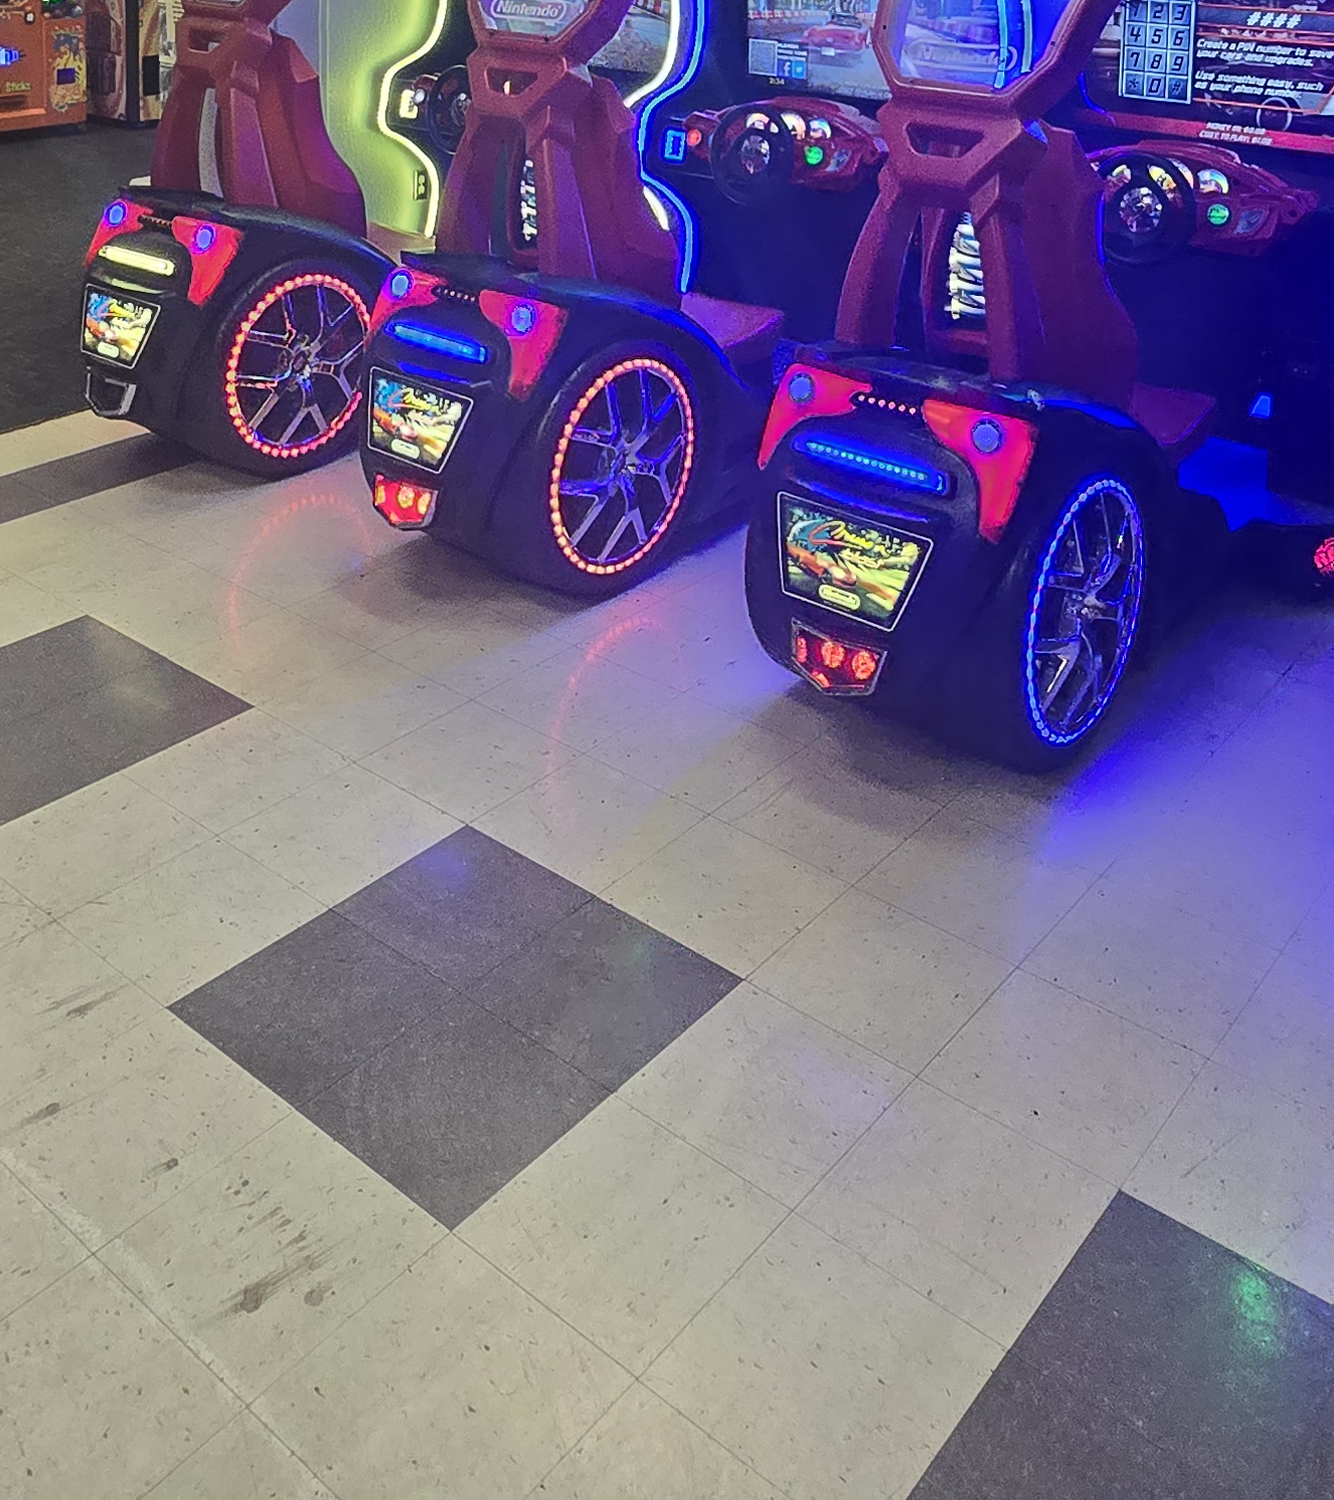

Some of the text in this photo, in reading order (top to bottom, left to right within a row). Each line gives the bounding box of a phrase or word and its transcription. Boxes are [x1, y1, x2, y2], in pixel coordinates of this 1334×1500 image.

[496, 0, 560, 17] Nintendo
[1152, 4, 1163, 19] 2
[1174, 5, 1187, 21] 3
[1129, 26, 1186, 46] 4 5 6
[1196, 38, 1229, 50] Create
[1237, 41, 1255, 52] PIN
[1256, 44, 1292, 58] number
[1130, 52, 1184, 71] 7 8 9
[5, 81, 31, 93] Sticks
[1148, 77, 1161, 93] 0
[1195, 70, 1215, 82] Use
[1216, 73, 1266, 88] something
[1297, 80, 1324, 92] such
[1209, 82, 1231, 94] your
[1233, 83, 1263, 97] phone
